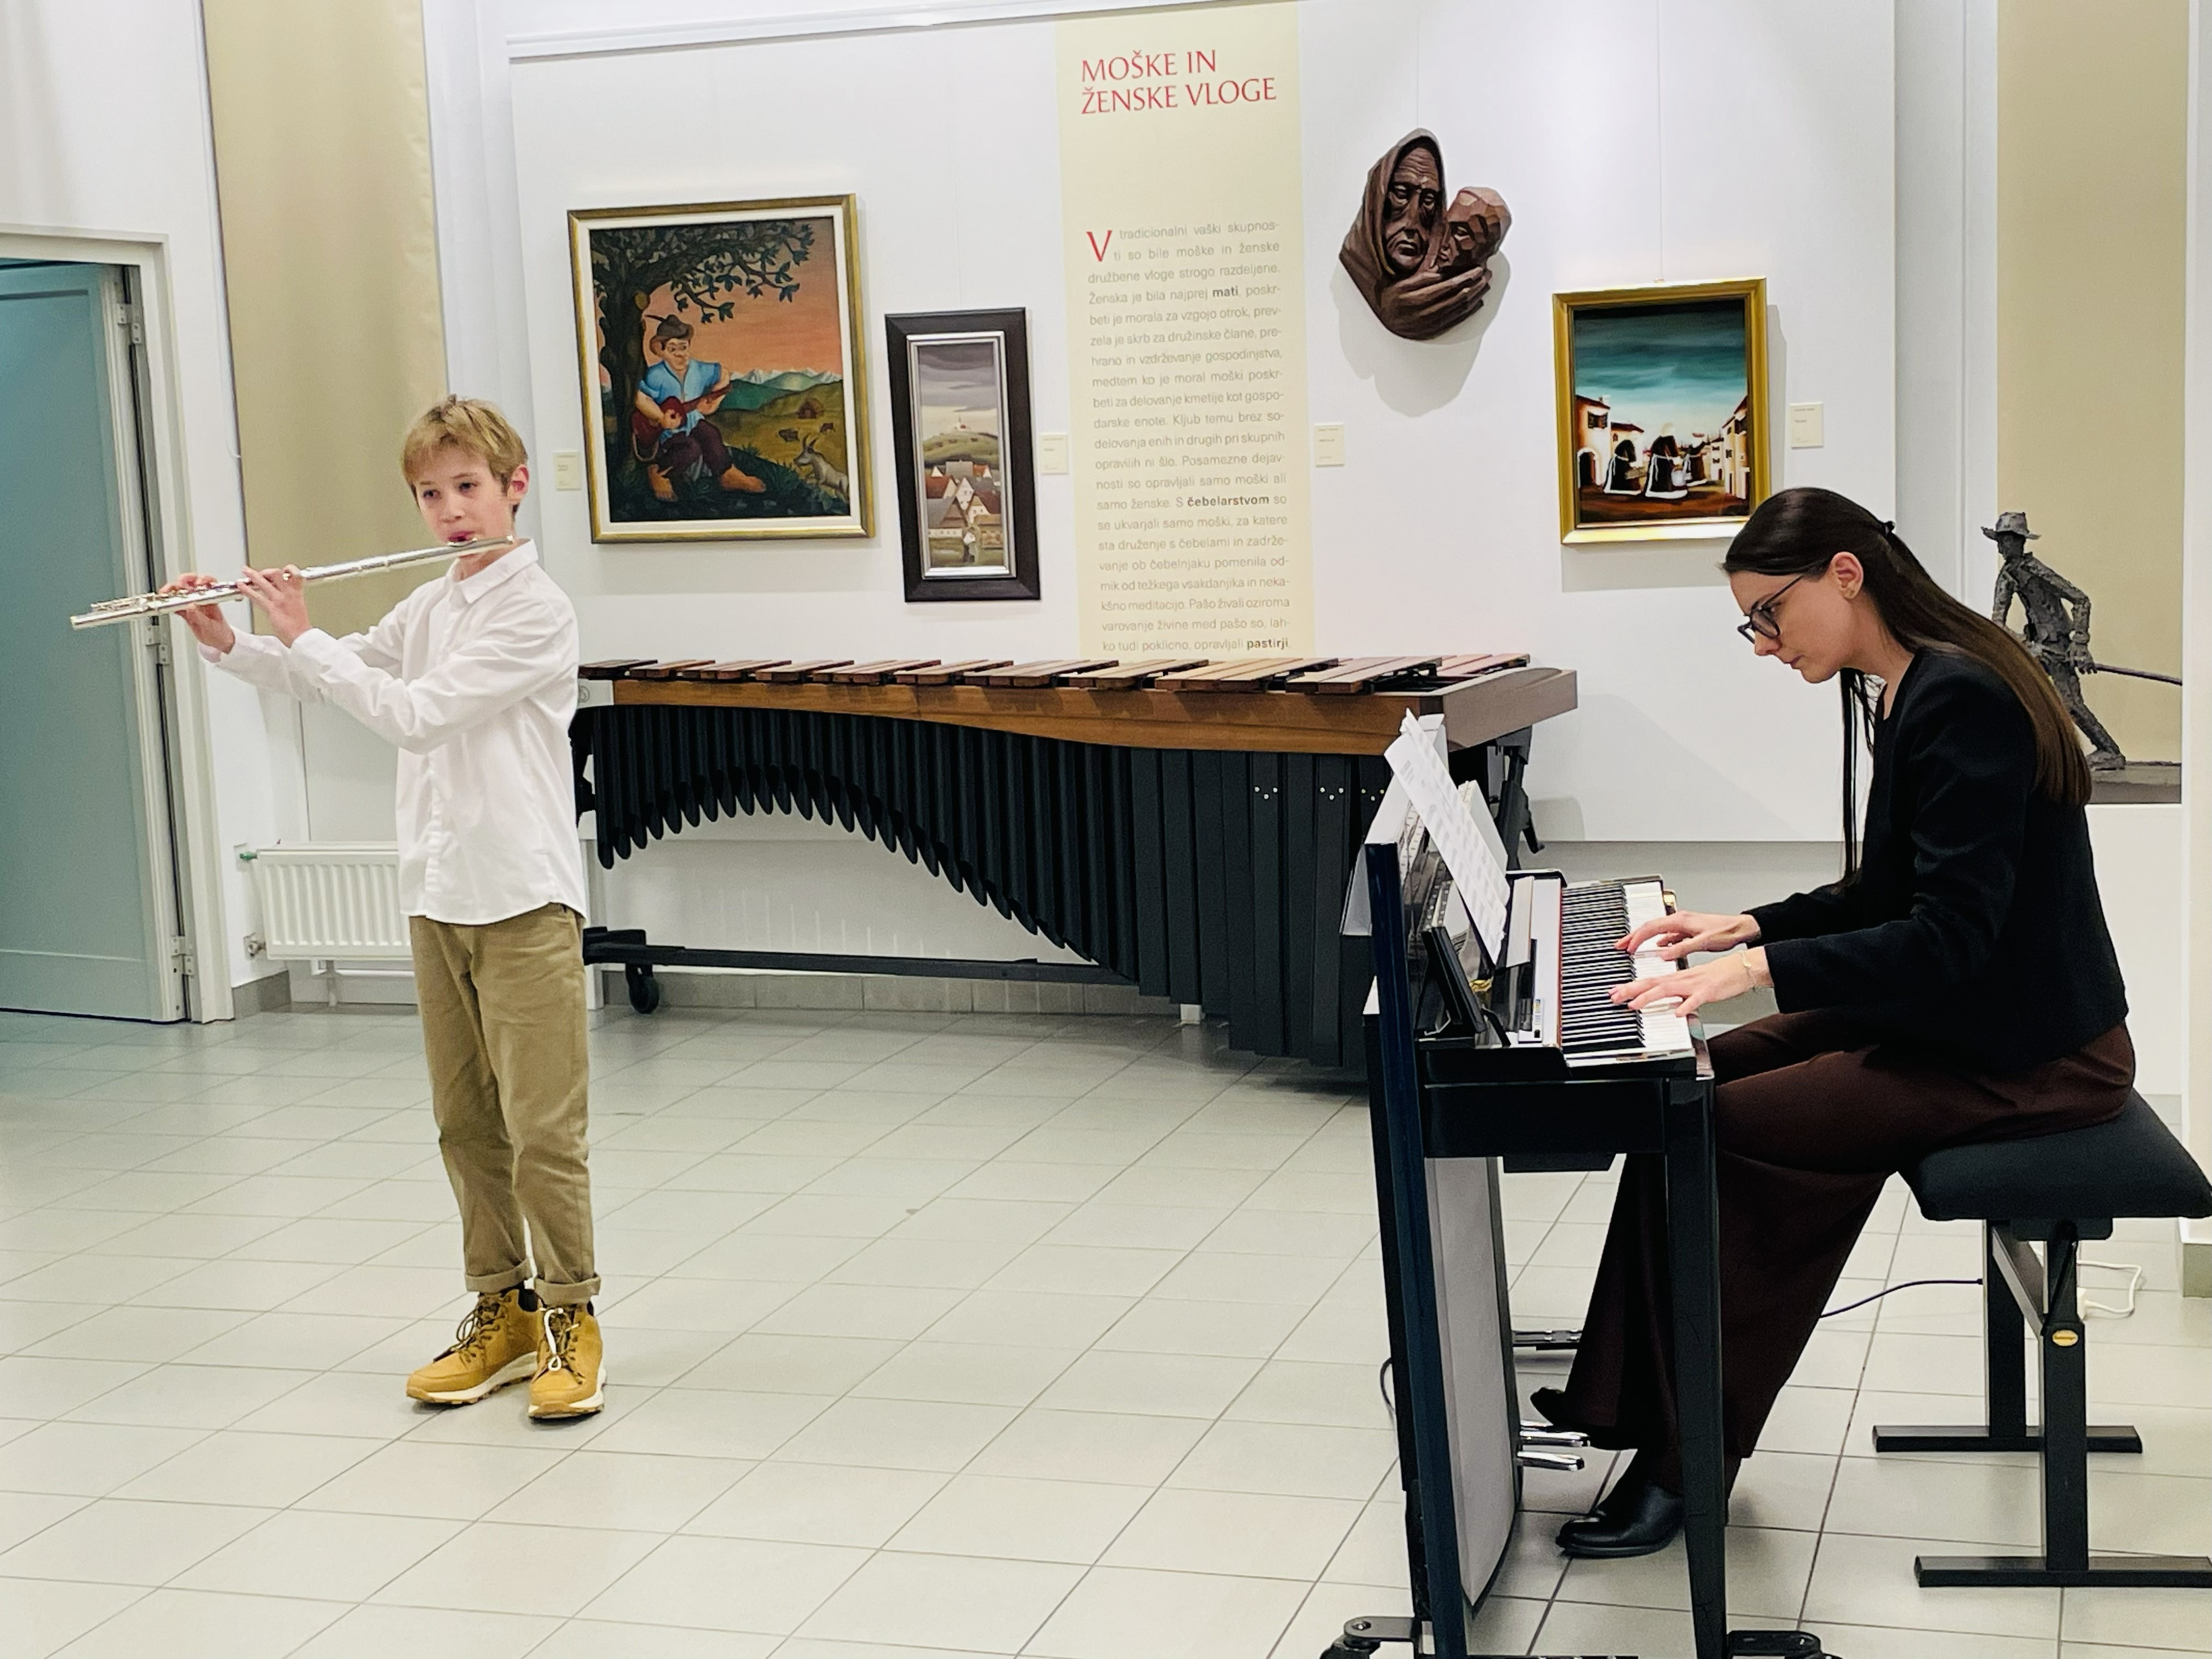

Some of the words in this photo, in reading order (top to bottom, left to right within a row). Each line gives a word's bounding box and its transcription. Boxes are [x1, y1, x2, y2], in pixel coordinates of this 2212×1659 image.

[1081, 50, 1178, 82] MOŠKE
[1187, 49, 1216, 74] IN
[1081, 85, 1178, 114] ŽENSKE
[1185, 77, 1277, 106] VLOGE
[1086, 230, 1113, 262] V
[1120, 226, 1187, 239] tradicionalni
[1193, 223, 1221, 235] vaški
[1114, 252, 1120, 260] ti
[1128, 251, 1142, 261] so
[1149, 249, 1169, 259] bile
[1176, 246, 1214, 257] moške
[1222, 246, 1232, 254] in
[1239, 241, 1279, 253] ženske
[1088, 272, 1140, 283] družbene
[1144, 269, 1175, 282] vloge
[1179, 268, 1215, 279] strogo
[1089, 291, 1128, 304] Ženska
[1132, 294, 1142, 304] je
[1146, 291, 1165, 301] bila
[1170, 290, 1208, 302] najprej
[1246, 284, 1281, 298] poskr-
[1090, 315, 1110, 325] beti
[1113, 315, 1122, 326] je
[1126, 312, 1163, 323] morala
[1166, 312, 1178, 321] za
[1181, 310, 1216, 322] vzgojo
[1254, 307, 1281, 318] prev-
[1090, 335, 1111, 346] zela
[1114, 336, 1124, 348] je
[1127, 333, 1150, 344] skrb
[1153, 334, 1165, 342] za
[1168, 330, 1221, 342] družinske
[1260, 328, 1281, 339] pre-
[1091, 357, 1122, 366] hrano
[1139, 352, 1201, 364] vzdrževanje
[1092, 376, 1137, 387] medtem
[1142, 375, 1155, 385] ko
[1160, 375, 1169, 387] je
[1175, 373, 1205, 383] moral
[1211, 370, 1243, 381] moški
[1249, 369, 1283, 382] poskr-
[1093, 398, 1113, 408] beti
[1115, 398, 1127, 407] za
[1130, 396, 1182, 407] delovanje
[1184, 393, 1223, 404] kmetije
[1226, 392, 1242, 402] kot
[1245, 392, 1284, 403] gospo-
[1094, 417, 1130, 429] darske
[1173, 414, 1200, 427] Kljub
[1205, 414, 1233, 424] temu
[1238, 412, 1262, 422] brez
[1267, 412, 1284, 421] so-
[1094, 439, 1146, 449] delovanja
[1149, 436, 1172, 447] enih
[1187, 433, 1222, 447] drugih
[1224, 435, 1239, 445] pri
[1242, 431, 1285, 444] skupnih
[1096, 458, 1141, 471] opravilih
[1182, 455, 1247, 466] Posamezne
[1096, 479, 1123, 489] nosti
[1128, 480, 1141, 489] so
[1199, 477, 1231, 486] samo
[1235, 473, 1268, 484] moški
[1273, 473, 1286, 483] ali
[1097, 501, 1127, 510] samo
[1176, 496, 1183, 507] S
[1187, 495, 1269, 507] čebelarstvom
[1274, 495, 1286, 505] so
[1098, 522, 1110, 531] se
[1114, 518, 1160, 531] ukvarjali
[1163, 520, 1193, 528] samo
[1237, 517, 1249, 526] za
[1253, 515, 1288, 525] katere
[1098, 541, 1115, 551] sta
[1118, 539, 1166, 551] druženje
[1170, 540, 1176, 549] s
[1179, 538, 1229, 549] čebelami
[1233, 538, 1243, 546] in
[1099, 562, 1128, 572] vanje
[1132, 560, 1146, 570] ob
[1150, 559, 1210, 571] čebelnjaku
[1215, 557, 1266, 569] pomenila
[1271, 555, 1289, 566] od-
[1101, 582, 1119, 590] mik
[1122, 580, 1135, 590] od
[1138, 579, 1180, 591] težkega
[1182, 578, 1244, 590] vsakdanjika
[1260, 577, 1289, 587] neka-
[1102, 601, 1126, 611] kšno
[1189, 598, 1216, 609] Pašo
[1218, 598, 1244, 608] živali
[1246, 599, 1290, 608] oziroma
[1102, 622, 1154, 632] varovanje
[1158, 619, 1188, 630] živine
[1192, 619, 1216, 629] med
[1221, 618, 1247, 630] pašo
[1103, 641, 1115, 651] ko
[1118, 641, 1138, 651] tudi
